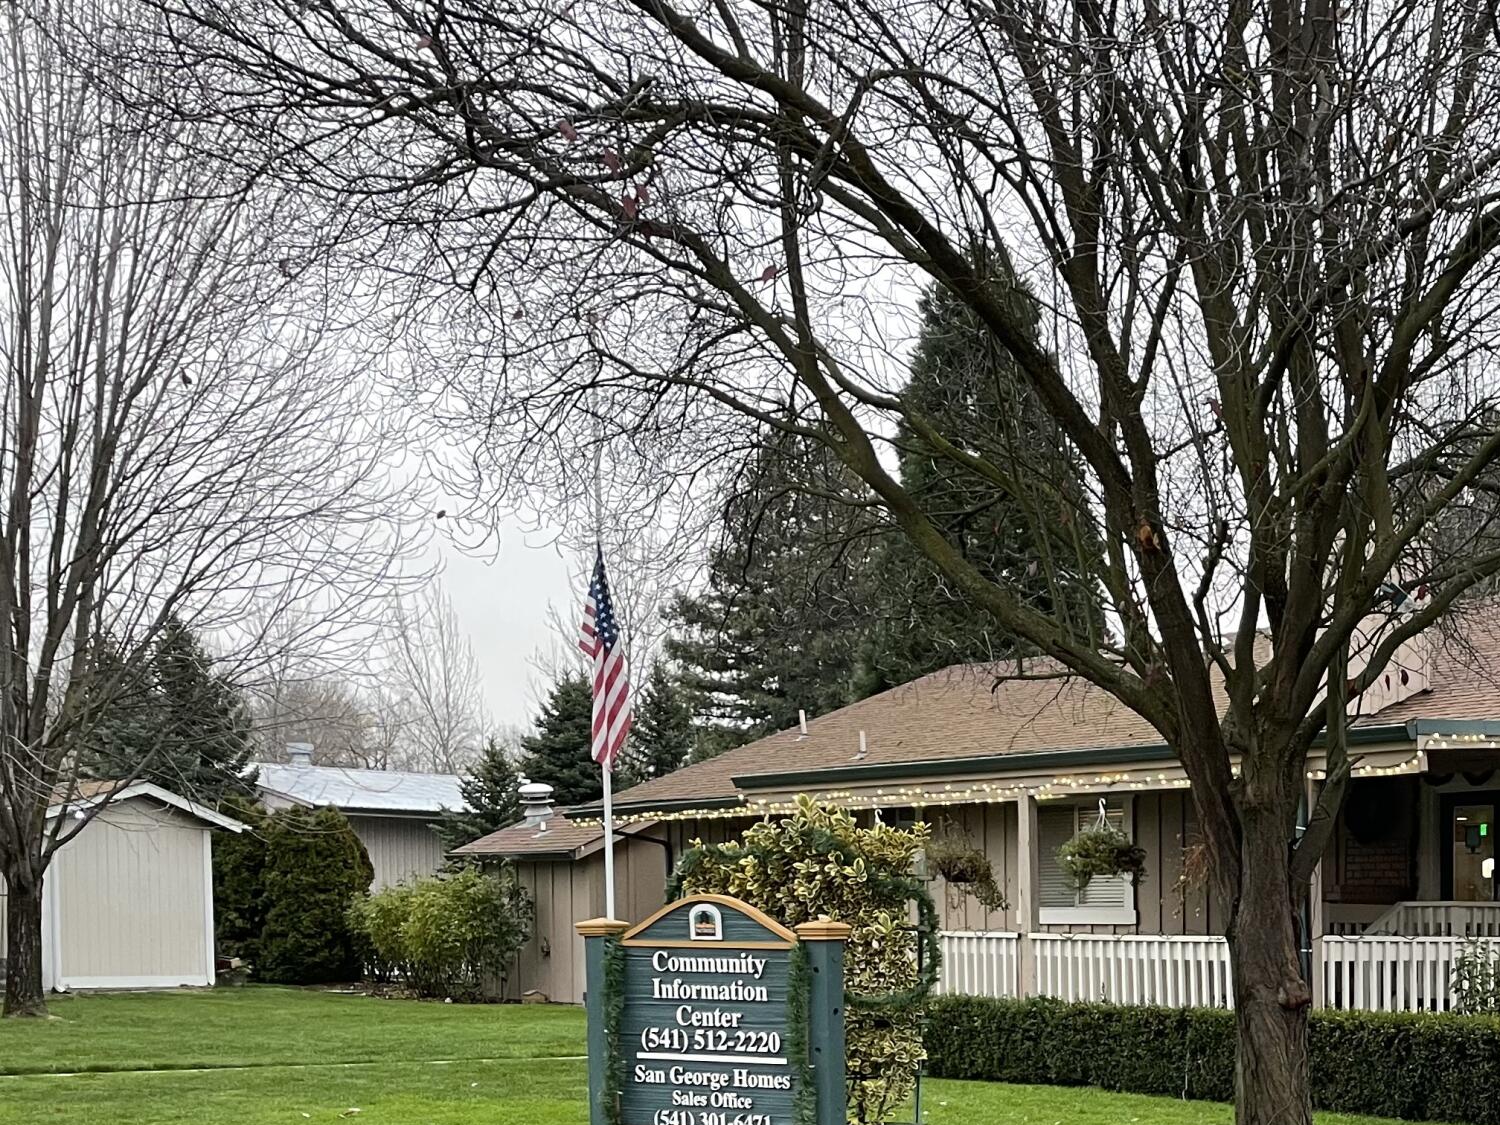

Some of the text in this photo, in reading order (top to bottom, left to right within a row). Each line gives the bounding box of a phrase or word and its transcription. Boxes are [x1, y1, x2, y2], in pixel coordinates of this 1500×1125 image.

[652, 951, 767, 979] Community
[652, 978, 768, 1002] Information
[676, 1006, 743, 1028] Center
[641, 1027, 781, 1054] (541) 512-2220
[634, 1065, 791, 1090] San George Homes
[672, 1091, 753, 1110] Sales Office
